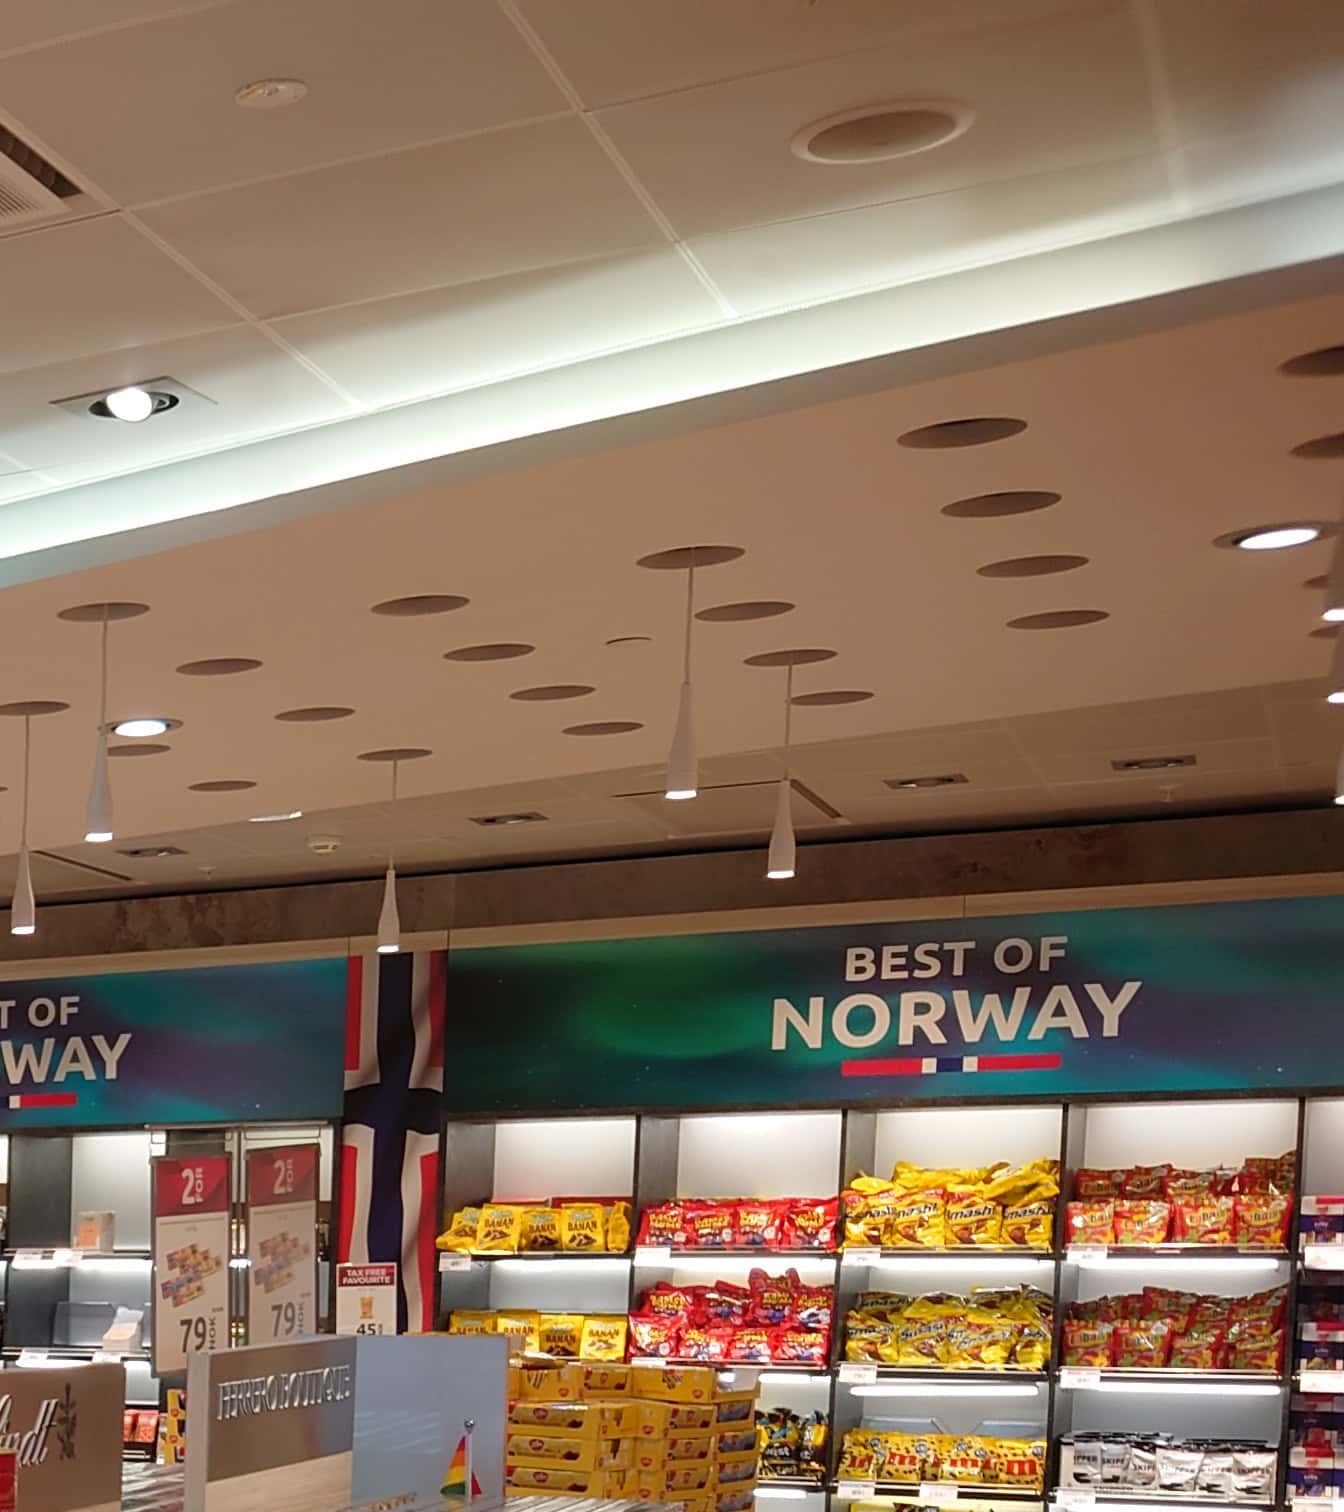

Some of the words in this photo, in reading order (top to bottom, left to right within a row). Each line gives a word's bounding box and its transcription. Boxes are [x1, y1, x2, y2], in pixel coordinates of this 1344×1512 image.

[846, 941, 974, 981] BEST
[993, 936, 1067, 971] OF
[28, 997, 79, 1025] OF
[771, 980, 1142, 1050] NORWAY
[182, 1168, 194, 1204] 2
[274, 1160, 286, 1194] 2
[343, 1275, 390, 1285] FAVOURITE
[346, 1268, 364, 1276] TAX
[180, 1317, 206, 1352] 79
[271, 1302, 296, 1337] 79
